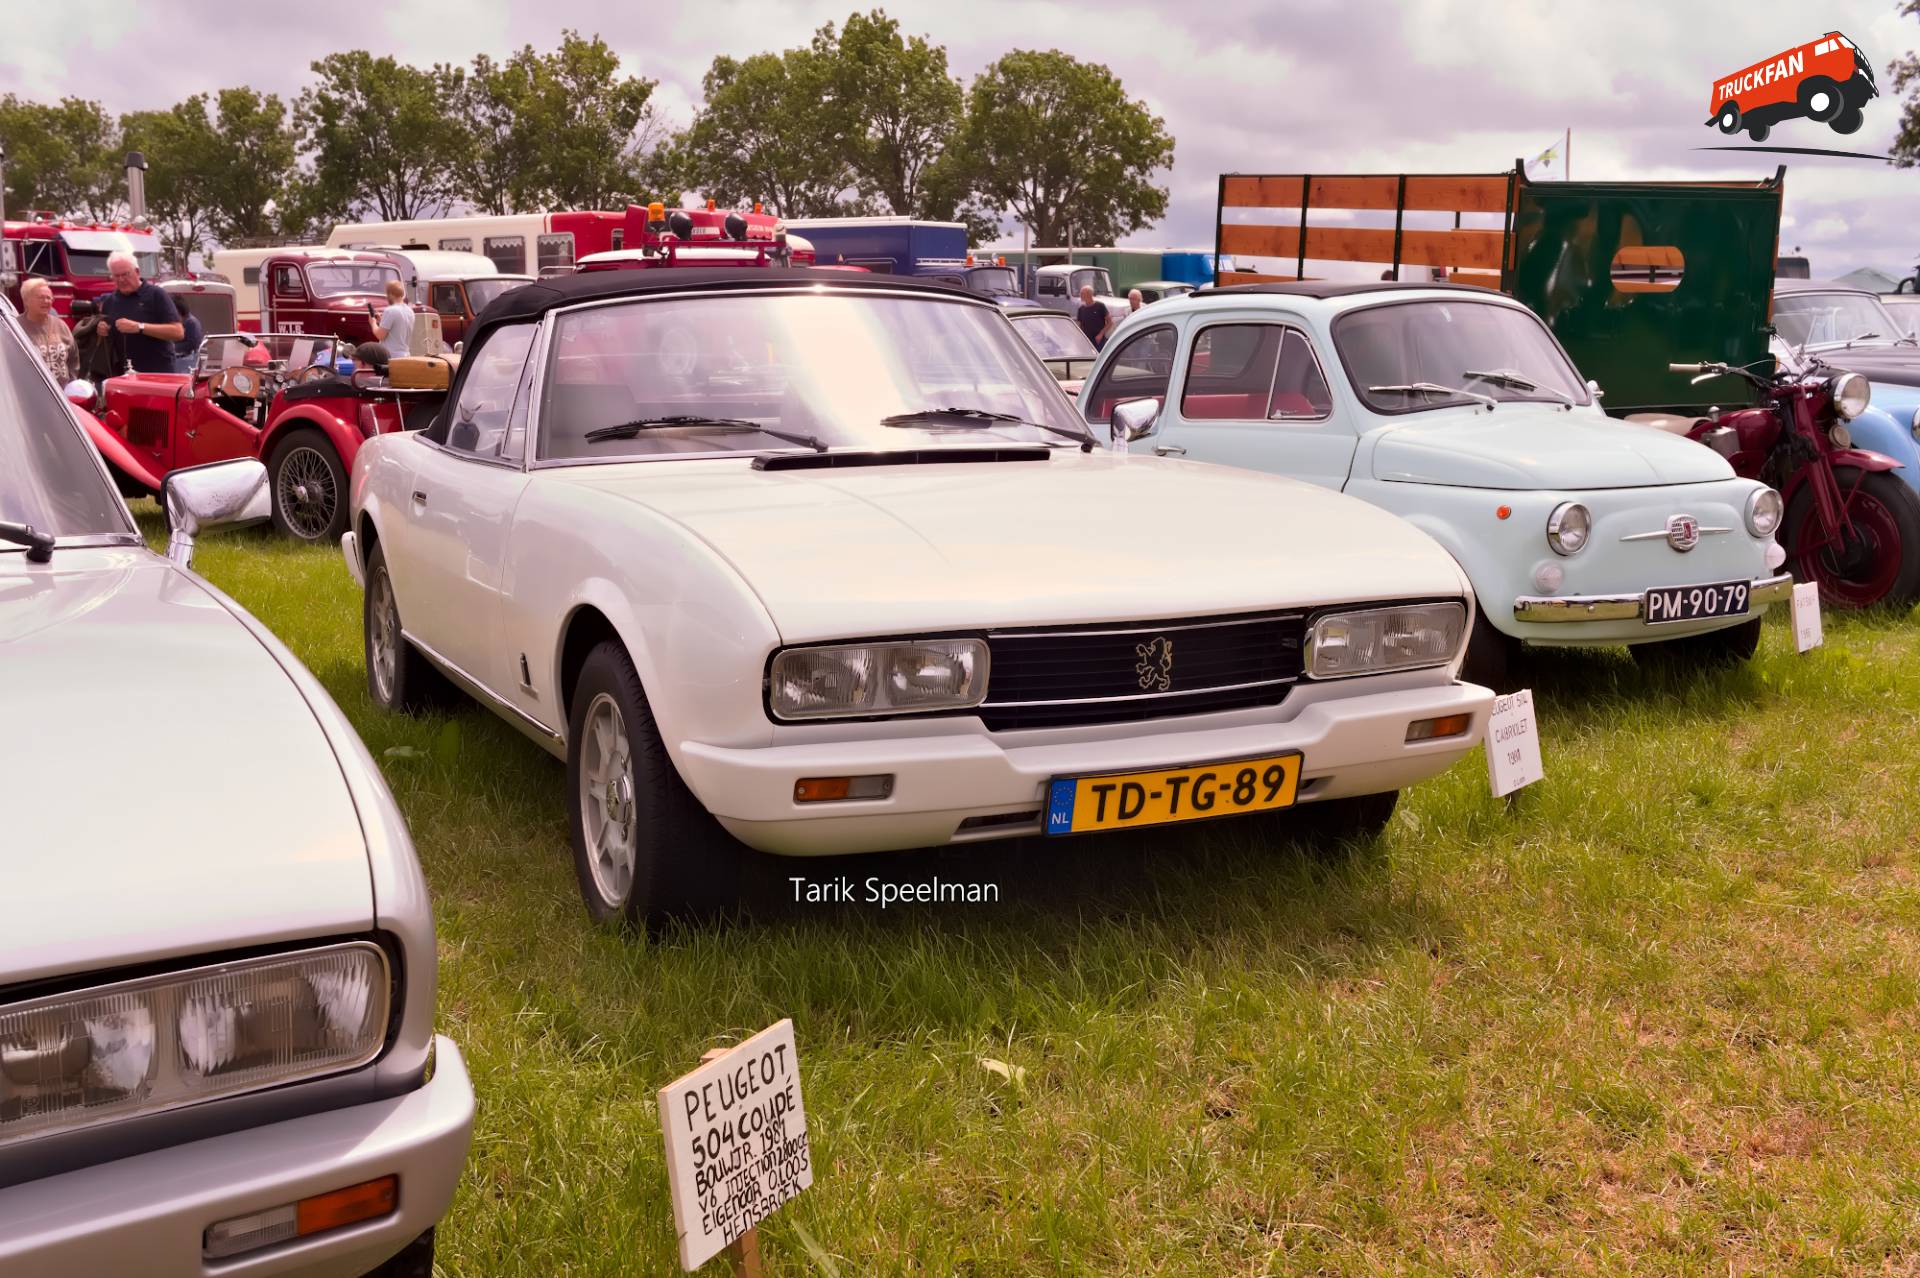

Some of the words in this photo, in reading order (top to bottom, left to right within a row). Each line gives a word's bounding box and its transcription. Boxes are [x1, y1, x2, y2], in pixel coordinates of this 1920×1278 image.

[1648, 584, 1747, 620] PM-90-79
[1051, 812, 1069, 825] NL
[1091, 764, 1286, 822] TD-TG-89
[684, 1044, 787, 1132] PEUGEOT
[760, 1118, 787, 1155] 1981
[699, 1188, 717, 1214] V6
